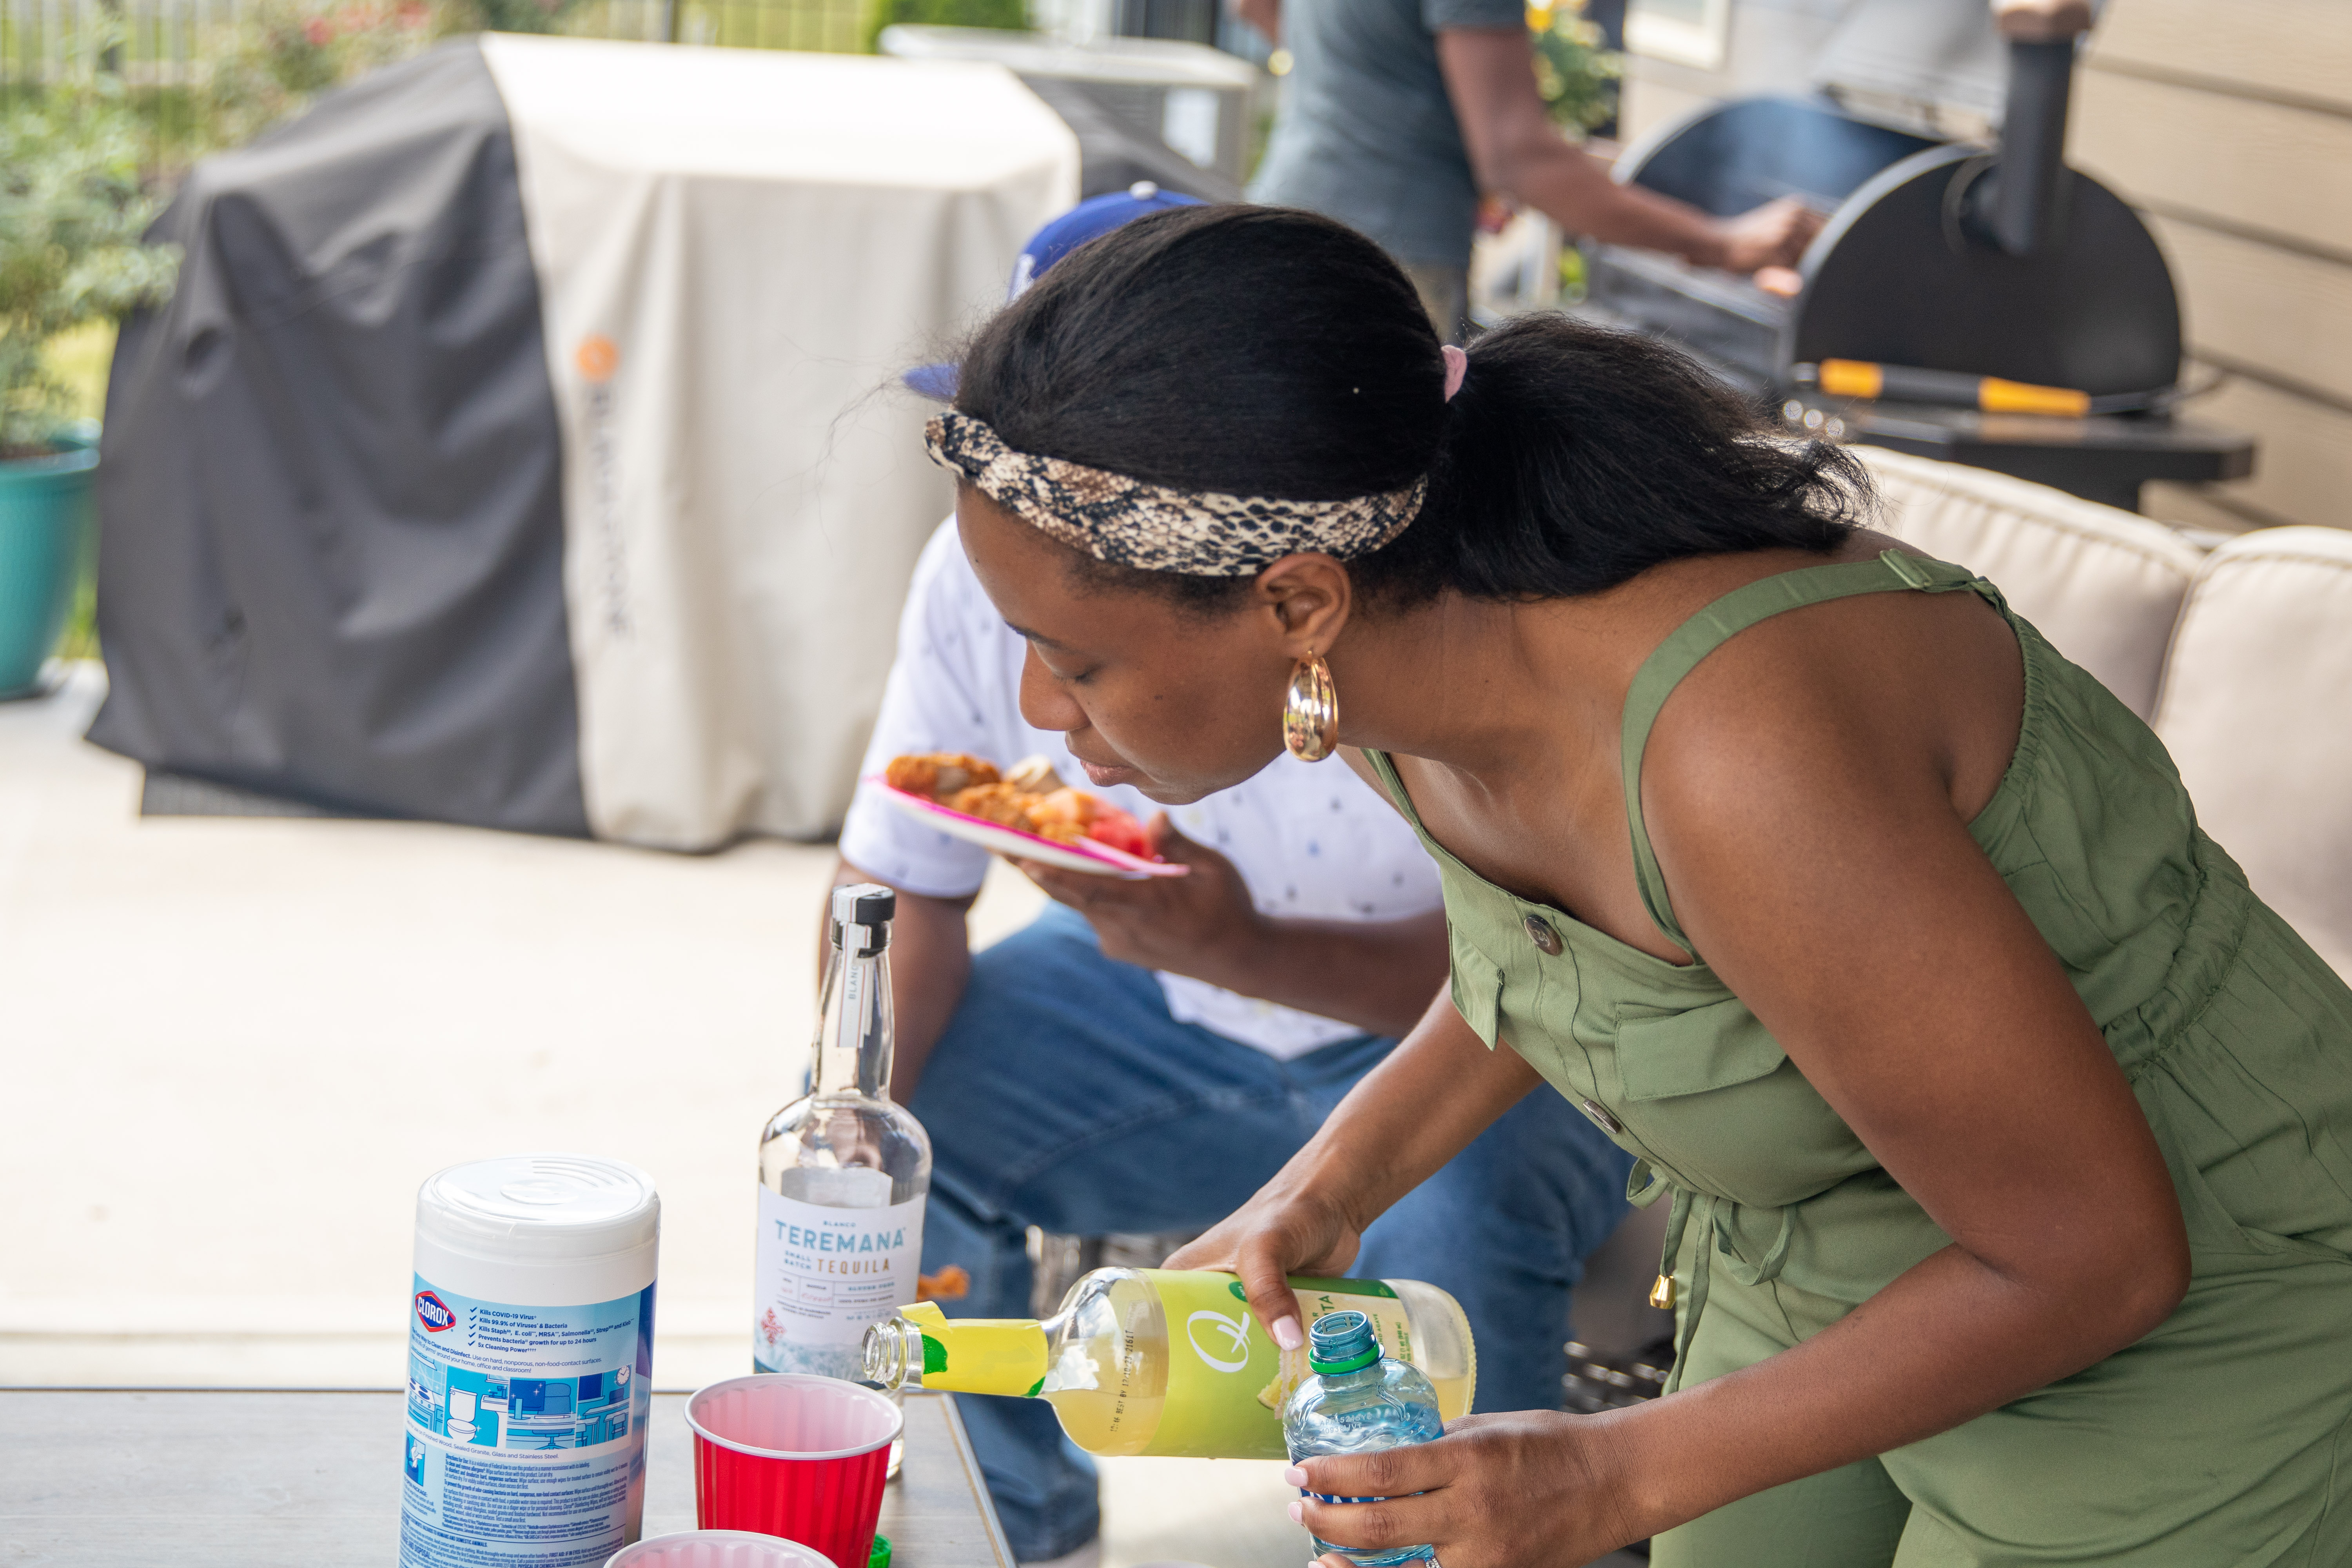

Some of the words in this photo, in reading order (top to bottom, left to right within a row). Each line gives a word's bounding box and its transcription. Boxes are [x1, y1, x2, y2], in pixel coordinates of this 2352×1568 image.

[775, 1219, 904, 1252] TEREMANA
[784, 1258, 811, 1269] BATCH
[785, 1250, 811, 1261] SMALL
[818, 1258, 889, 1274] TEQUILA
[418, 1296, 449, 1327] CLOROX
[1187, 1310, 1251, 1373] Q
[431, 1341, 441, 1349] Clean
[450, 1348, 471, 1359] Disinfect.
[436, 1352, 450, 1360] around
[1116, 1400, 1124, 1414] BEST
[423, 1432, 438, 1443] Finished
[439, 1439, 452, 1448] Wood,
